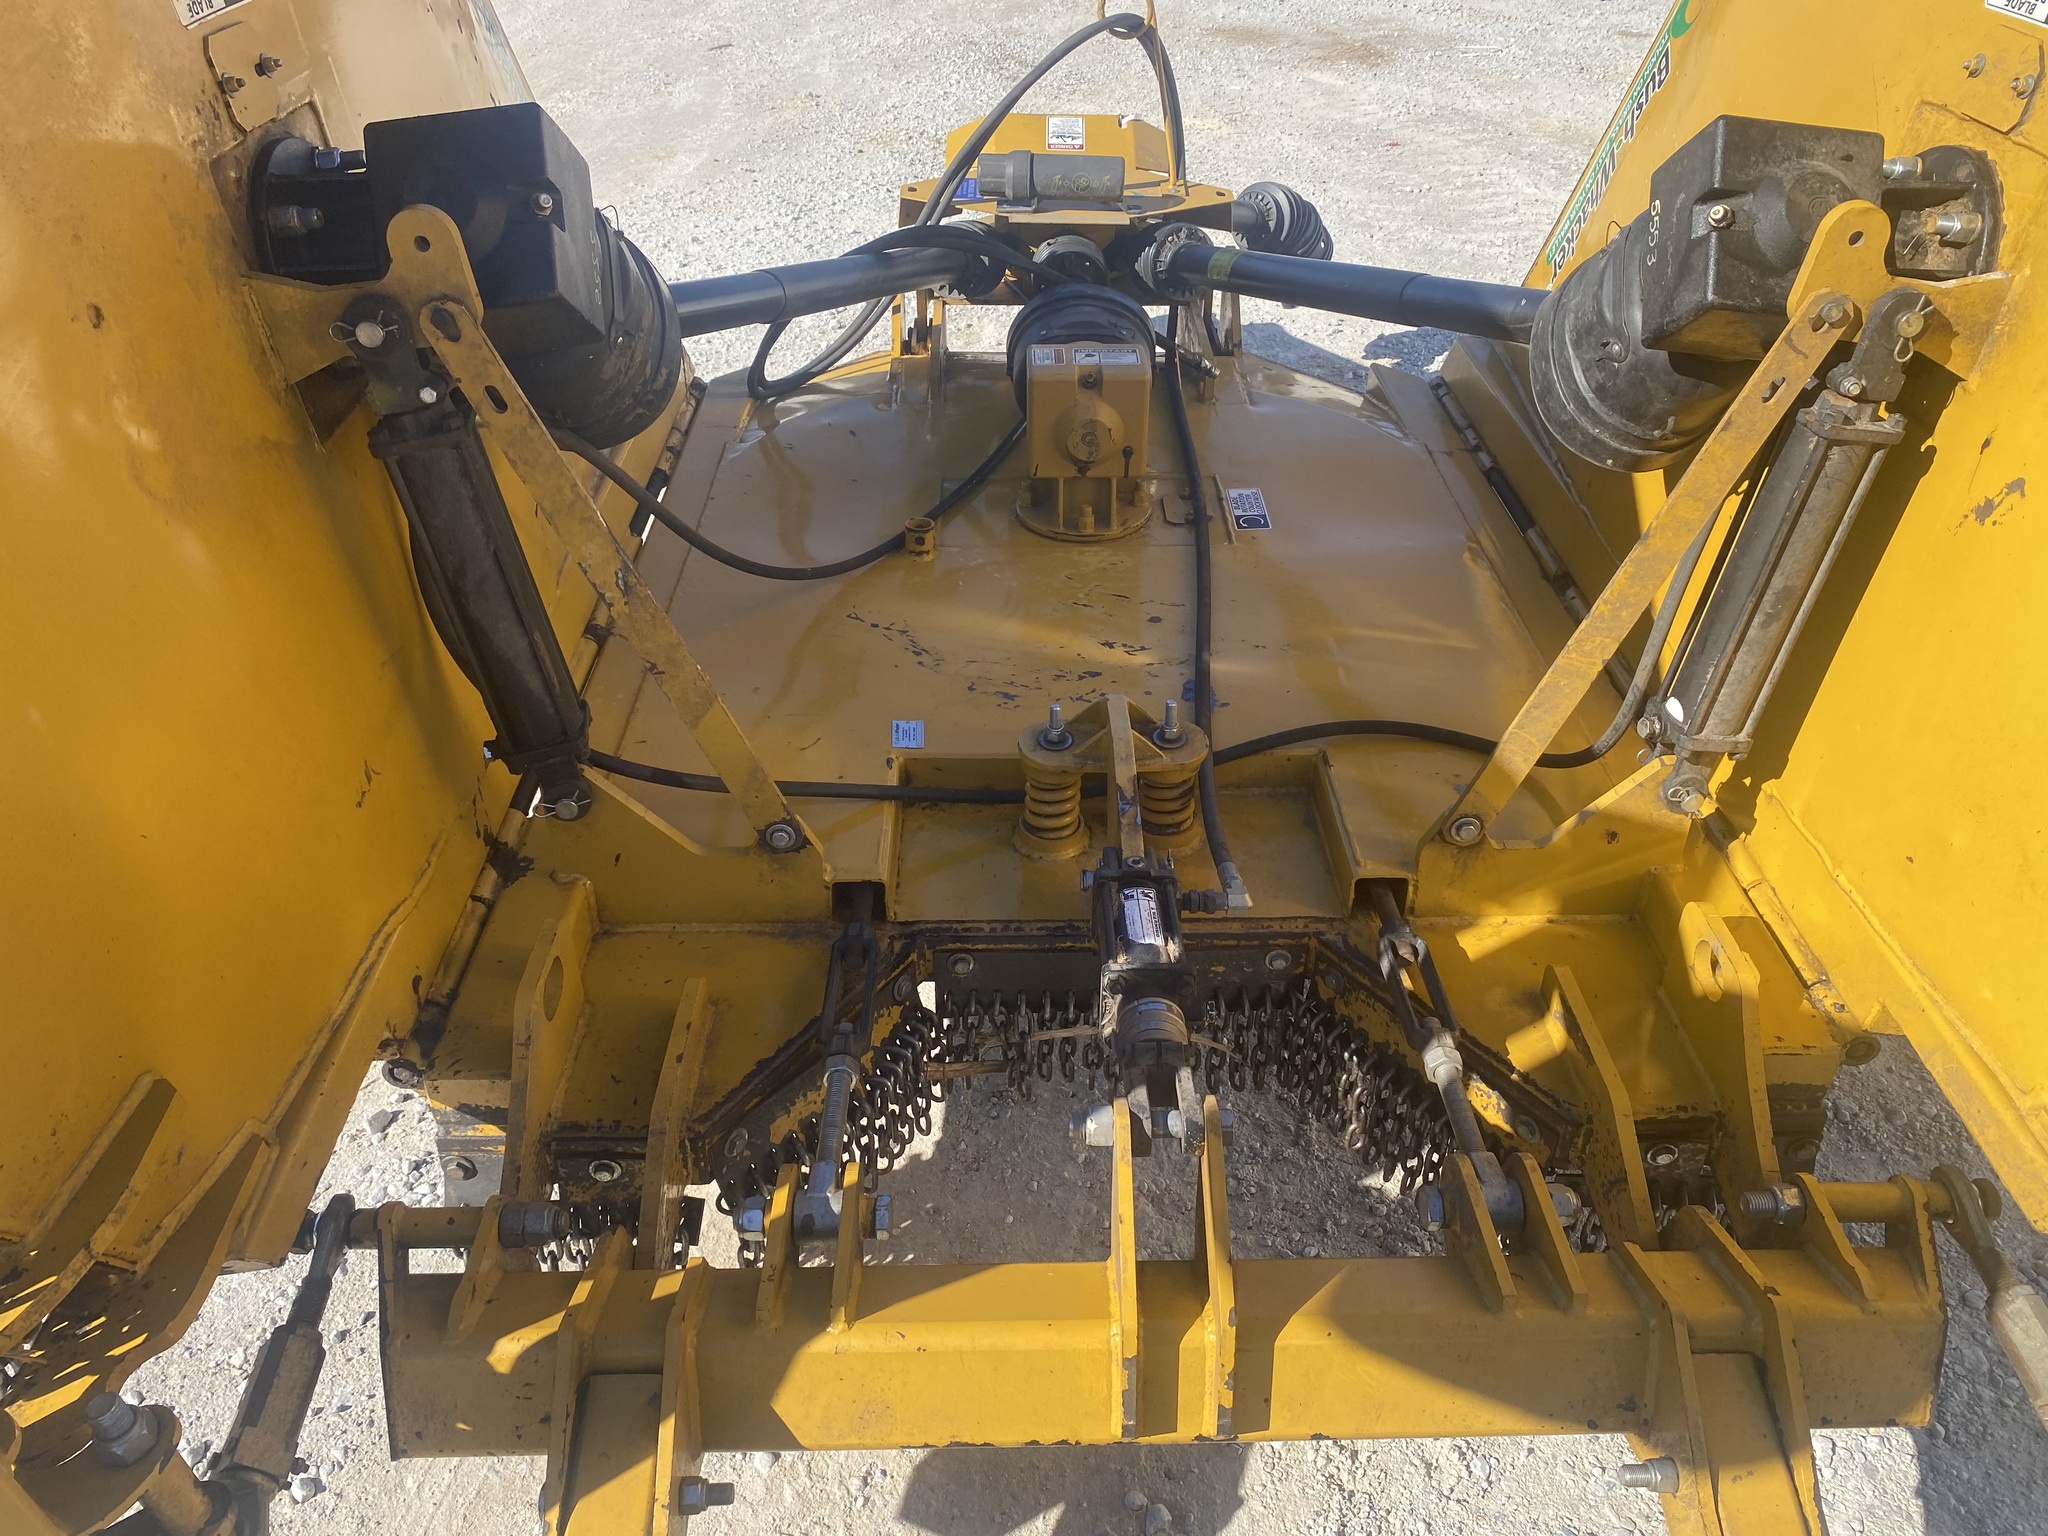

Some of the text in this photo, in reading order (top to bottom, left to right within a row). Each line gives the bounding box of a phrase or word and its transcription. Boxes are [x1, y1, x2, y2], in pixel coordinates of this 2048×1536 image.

[1643, 32, 1668, 79] TOUGH
[1632, 79, 1643, 101] ON
[1549, 219, 1570, 261] WALLET
[1231, 496, 1241, 510] BLADE
[1238, 493, 1248, 513] ROTATION
[1245, 494, 1255, 513] COUNTER
[1251, 491, 1263, 513] CLOCKWISE
[1152, 911, 1160, 938] WARNING
